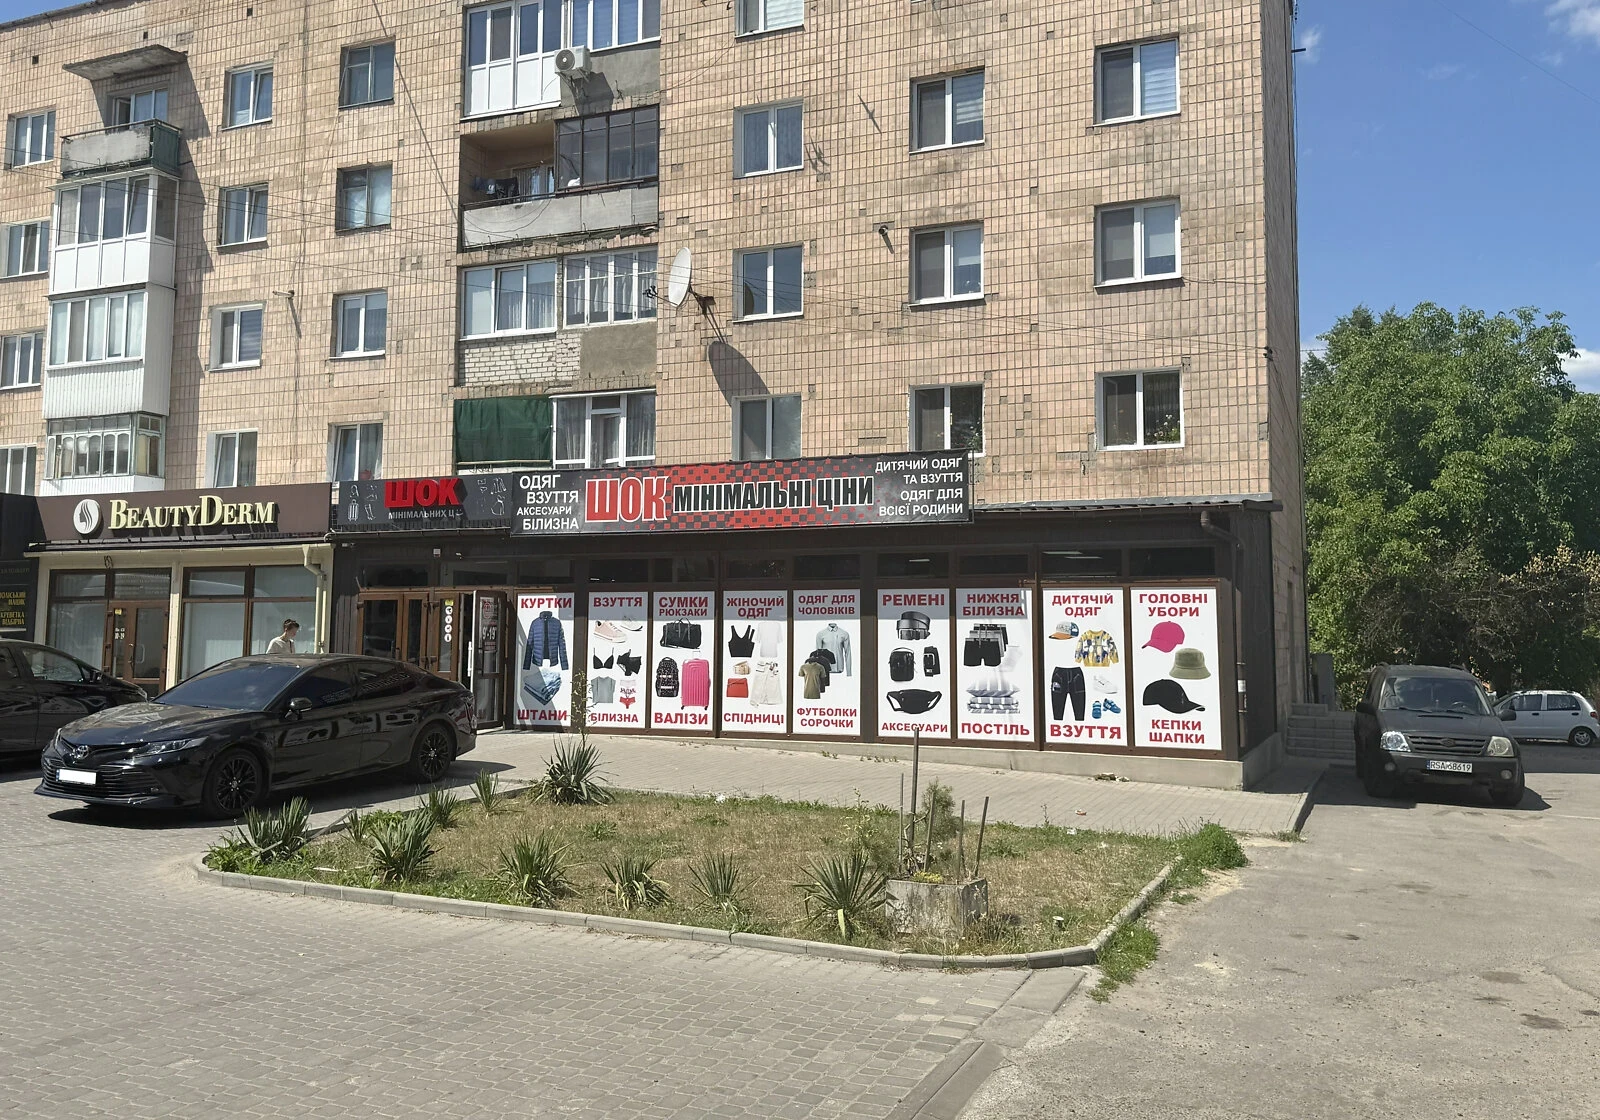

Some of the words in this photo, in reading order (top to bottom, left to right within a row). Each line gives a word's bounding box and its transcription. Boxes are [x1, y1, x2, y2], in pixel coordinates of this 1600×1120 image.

[875, 457, 928, 473] ДИТЯЧИЙ
[931, 457, 962, 470] ОДЯГ
[520, 474, 561, 490] ОДЯГ
[903, 474, 917, 485] ТА
[920, 472, 963, 484] ВЗУТТЯ
[384, 477, 461, 508] ШОК
[526, 490, 579, 504] ВЗУТТЯ
[900, 490, 934, 502] ОДЯГ
[937, 488, 963, 501] ДЛЯ
[585, 475, 668, 523] ШОК
[672, 478, 812, 513] МІНІМАЛЬНІ
[816, 475, 874, 511] ЦІНИ
[388, 509, 446, 519] МІНІМАЛЬНИХ
[516, 506, 572, 516] АКСЕСУАРИ
[879, 503, 910, 516] ВСІЄЇ
[913, 503, 963, 516] РОДИНИ
[523, 518, 579, 530] БІЛИЗНА
[521, 597, 572, 609] КУРТКИ
[593, 597, 643, 608] ВЗУТТЯ
[659, 596, 709, 608] СУМКИ
[726, 595, 785, 607] ЖІНОЧИЙ
[798, 595, 828, 605] ОДЯГ
[831, 595, 855, 605] ДЛЯ
[882, 593, 945, 606] РЕМЕНІ
[967, 593, 1020, 604] НИЖНЯ
[1138, 593, 1208, 604] ГОЛОВНІ
[659, 608, 708, 617] РЮКЗАКИ
[737, 607, 772, 619] ОДЯГ
[798, 606, 855, 616] ЧОЛОВІКІВ
[962, 606, 1025, 616] БІЛИЗНА
[1064, 606, 1102, 617] ОДЯГ
[1148, 606, 1200, 617] УБОРИ
[517, 710, 568, 721] ШТАНИ
[590, 713, 639, 723] БІЛИЗНА
[796, 707, 857, 717] ФУТБОЛКИ
[654, 712, 708, 725] ВАЛІЗИ
[723, 712, 785, 725] СПІДНИЦІ
[800, 718, 854, 728] СОРОЧКИ
[881, 722, 948, 733] АКСЕСУАРИ
[961, 722, 1030, 736] ПОСТІЛЬ
[1151, 719, 1202, 731] КЕПКИ
[1050, 724, 1122, 740] ВЗУТТЯ
[1149, 731, 1205, 744] ШАПКИ
